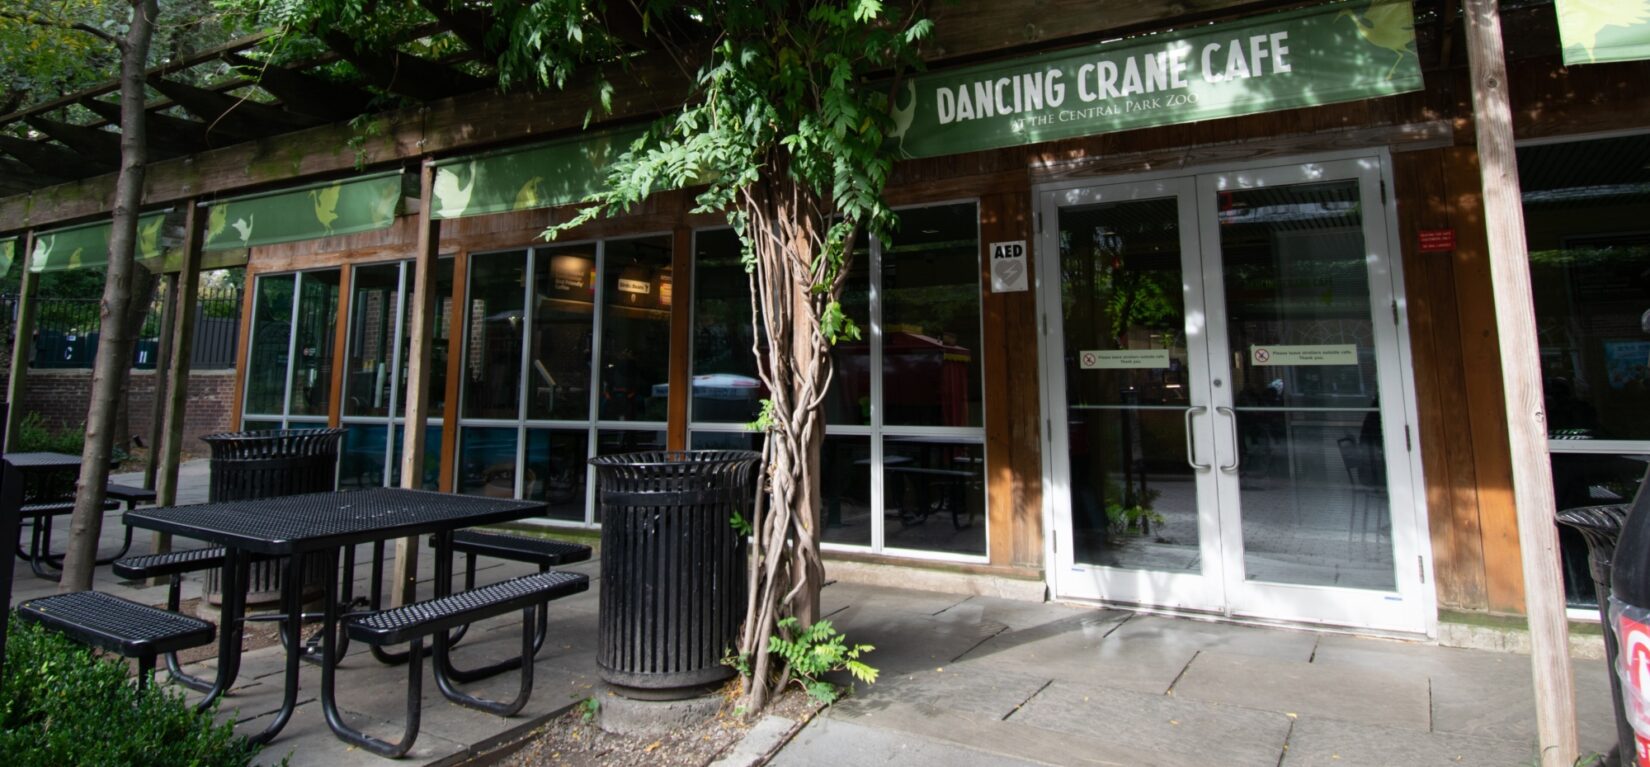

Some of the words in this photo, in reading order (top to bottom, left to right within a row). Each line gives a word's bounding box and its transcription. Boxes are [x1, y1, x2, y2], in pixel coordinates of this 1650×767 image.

[936, 68, 1066, 125] DANCING
[1077, 49, 1188, 102] CRANE
[1201, 31, 1292, 83] CAFE
[1027, 114, 1055, 127] THE
[1058, 104, 1121, 122] CENTRAL
[1125, 97, 1162, 113] PARK
[1166, 92, 1199, 107] ZOO
[994, 244, 1023, 259] AED
